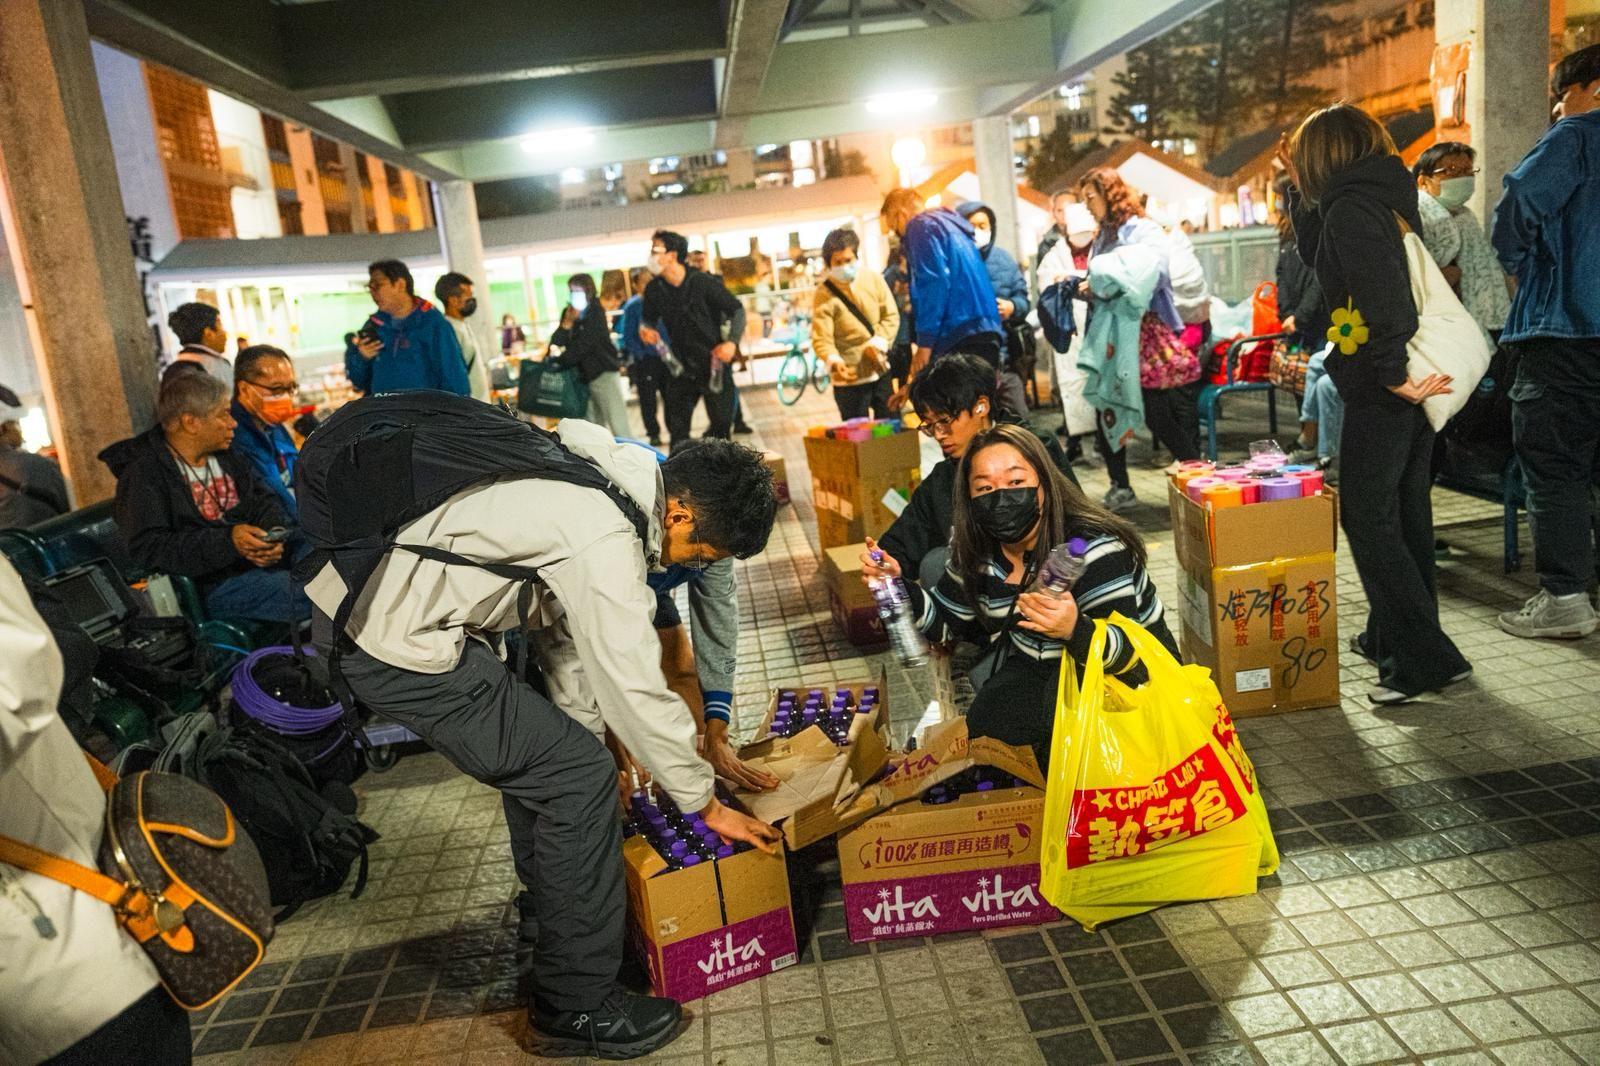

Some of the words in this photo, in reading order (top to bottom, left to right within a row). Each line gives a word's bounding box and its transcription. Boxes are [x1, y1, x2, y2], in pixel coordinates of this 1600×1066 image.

[1282, 636, 1327, 690] 80
[1171, 761, 1197, 788] LAB
[862, 885, 941, 924] vita
[961, 874, 1040, 912] vita
[1011, 911, 1032, 920] Water
[697, 932, 766, 975] vita
